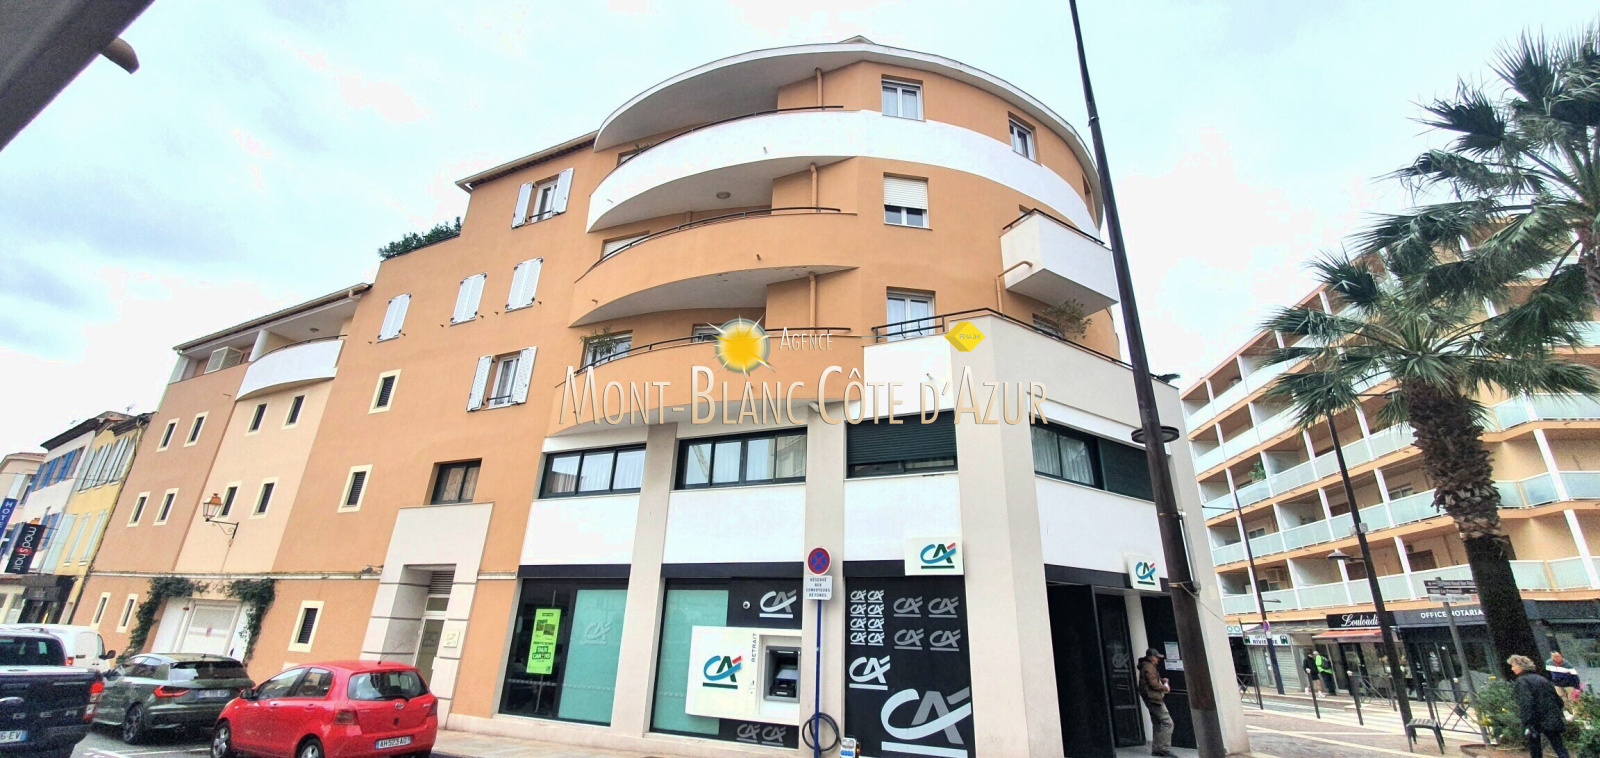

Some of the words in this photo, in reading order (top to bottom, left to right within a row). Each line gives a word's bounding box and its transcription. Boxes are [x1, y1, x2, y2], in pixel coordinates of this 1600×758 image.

[920, 542, 957, 564] CA
[760, 589, 797, 612] CA
[1420, 611, 1448, 619] OFFICE
[704, 655, 743, 682] CA
[849, 655, 890, 683] CA
[881, 686, 972, 744] CA
